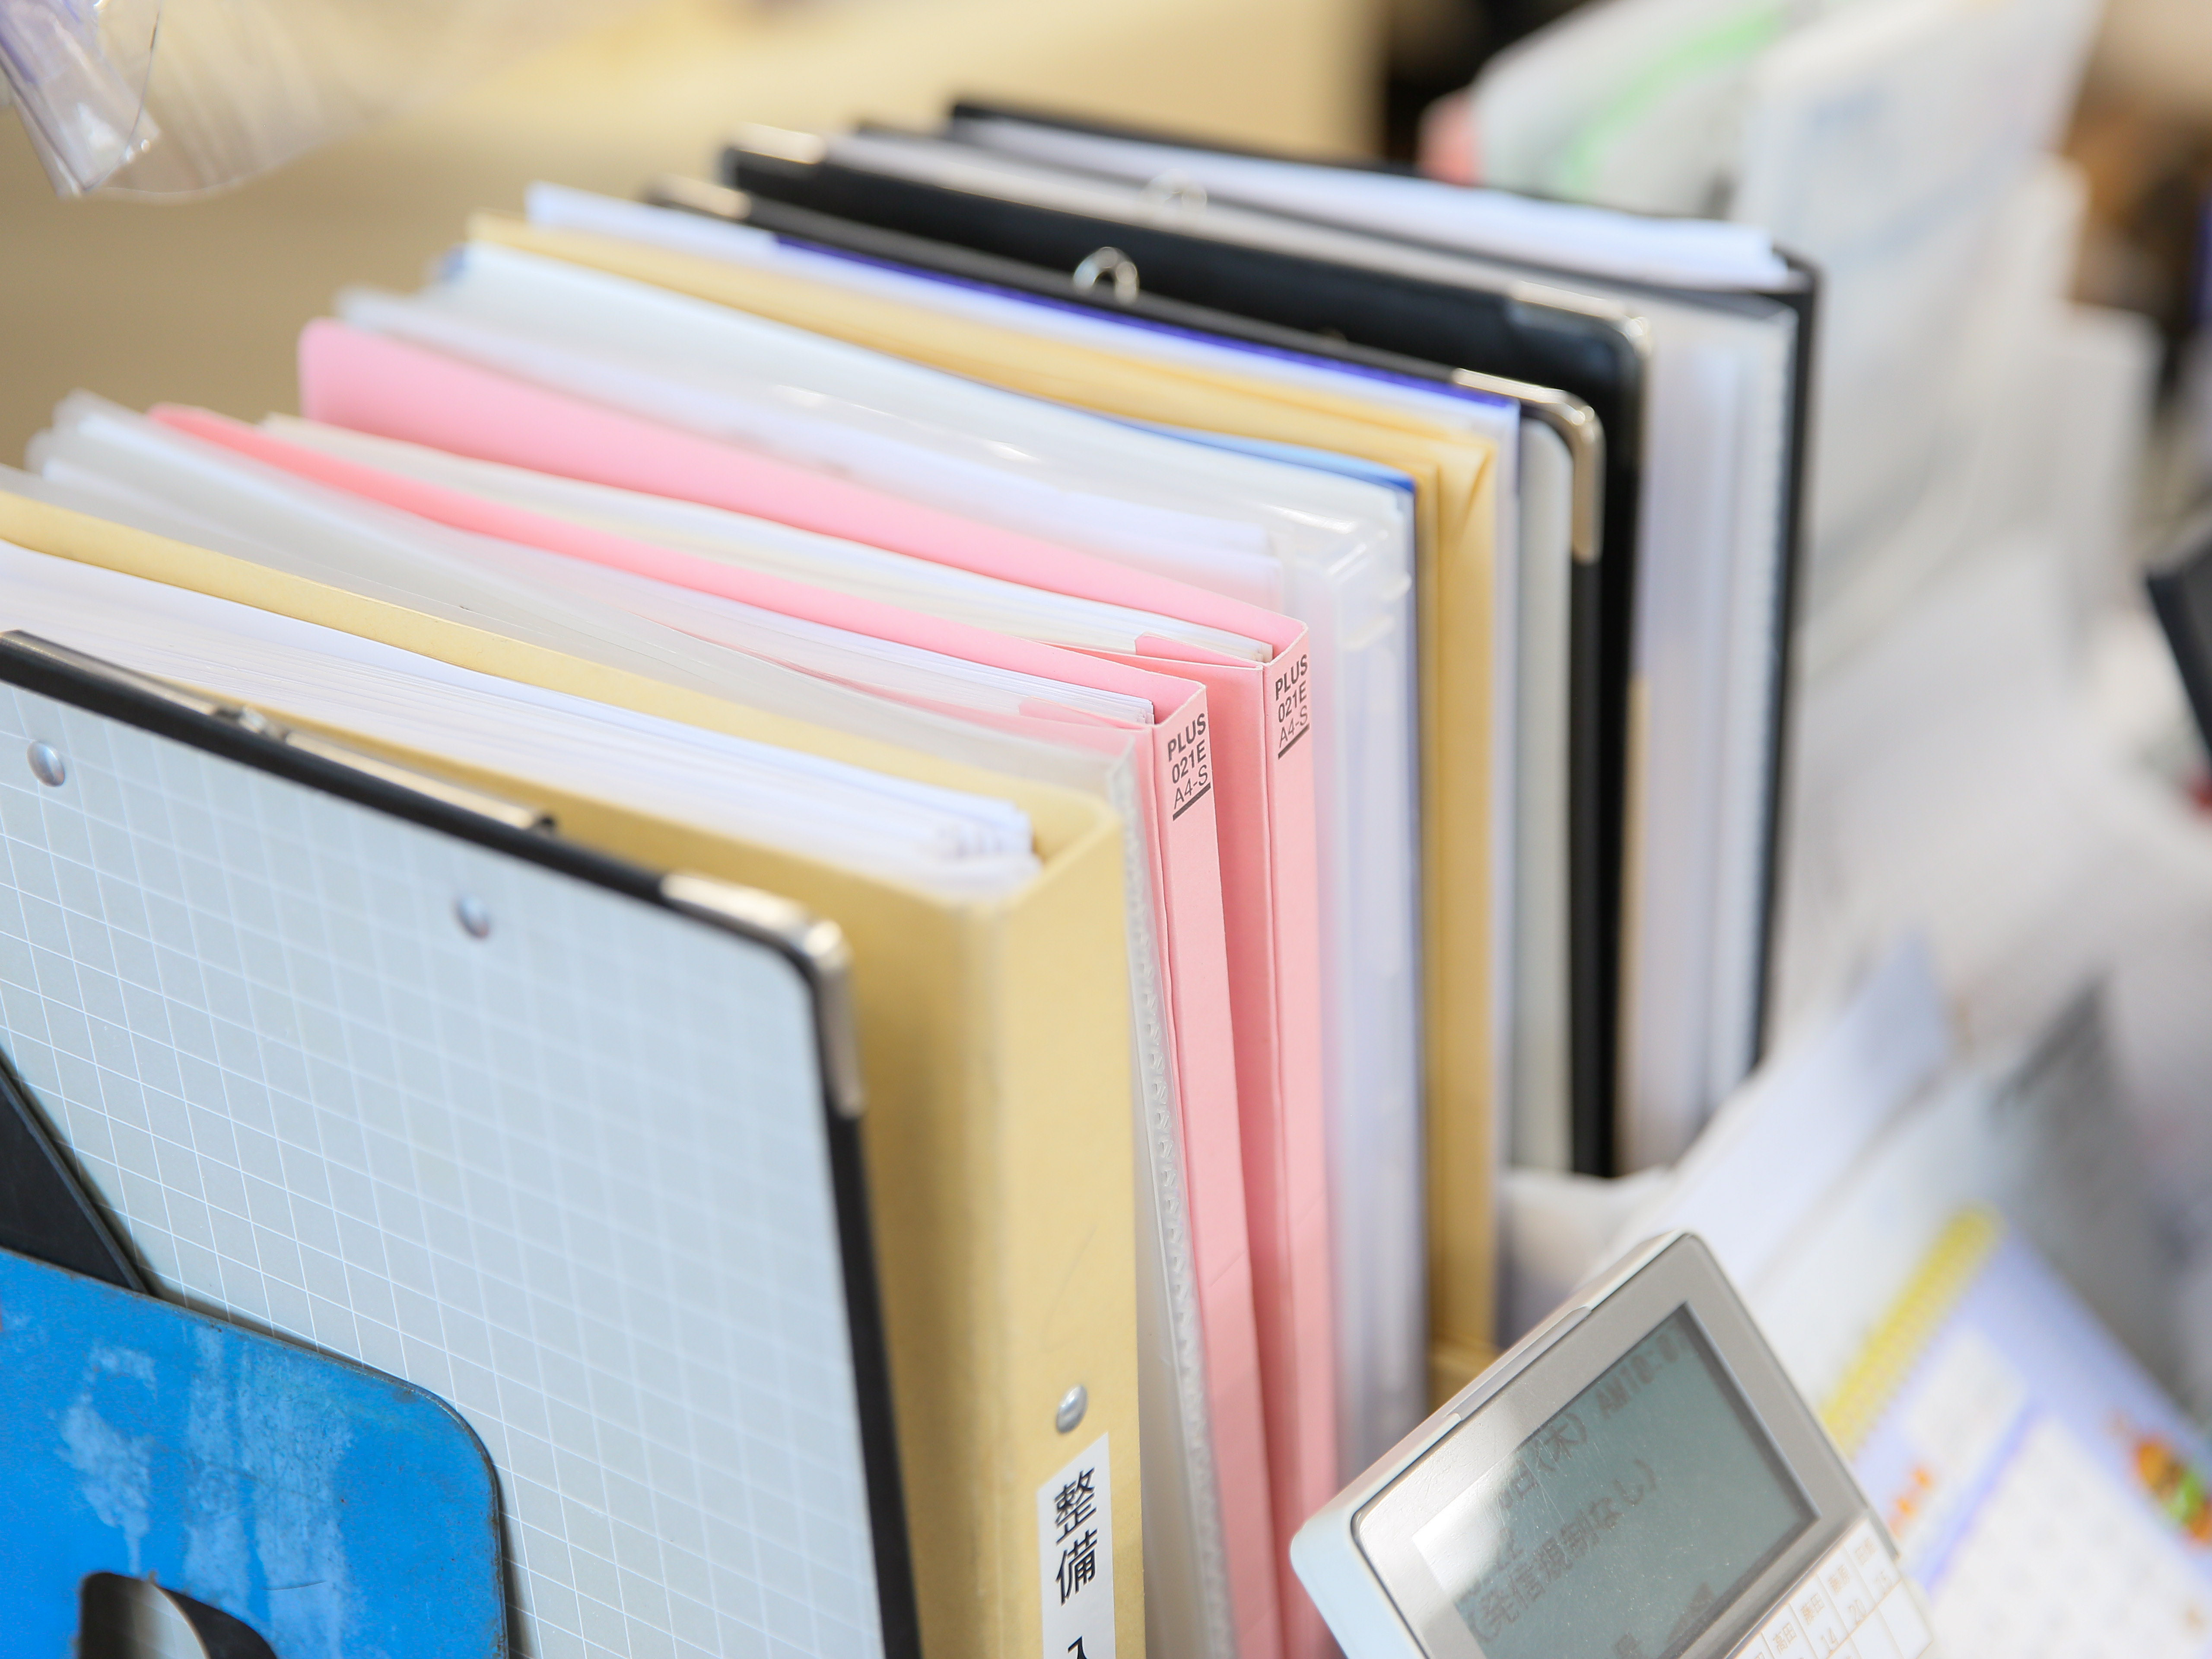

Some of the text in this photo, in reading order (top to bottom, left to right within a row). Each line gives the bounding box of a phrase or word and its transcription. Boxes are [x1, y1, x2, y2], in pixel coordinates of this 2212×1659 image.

[1275, 654, 1308, 701] PLUS
[1278, 680, 1307, 723] 021E
[1168, 713, 1206, 762] PLUS
[1279, 705, 1308, 748] A4-S
[1172, 739, 1206, 784] 021E
[1173, 764, 1208, 810] A4-S
[1054, 1466, 1098, 1607] 整備
